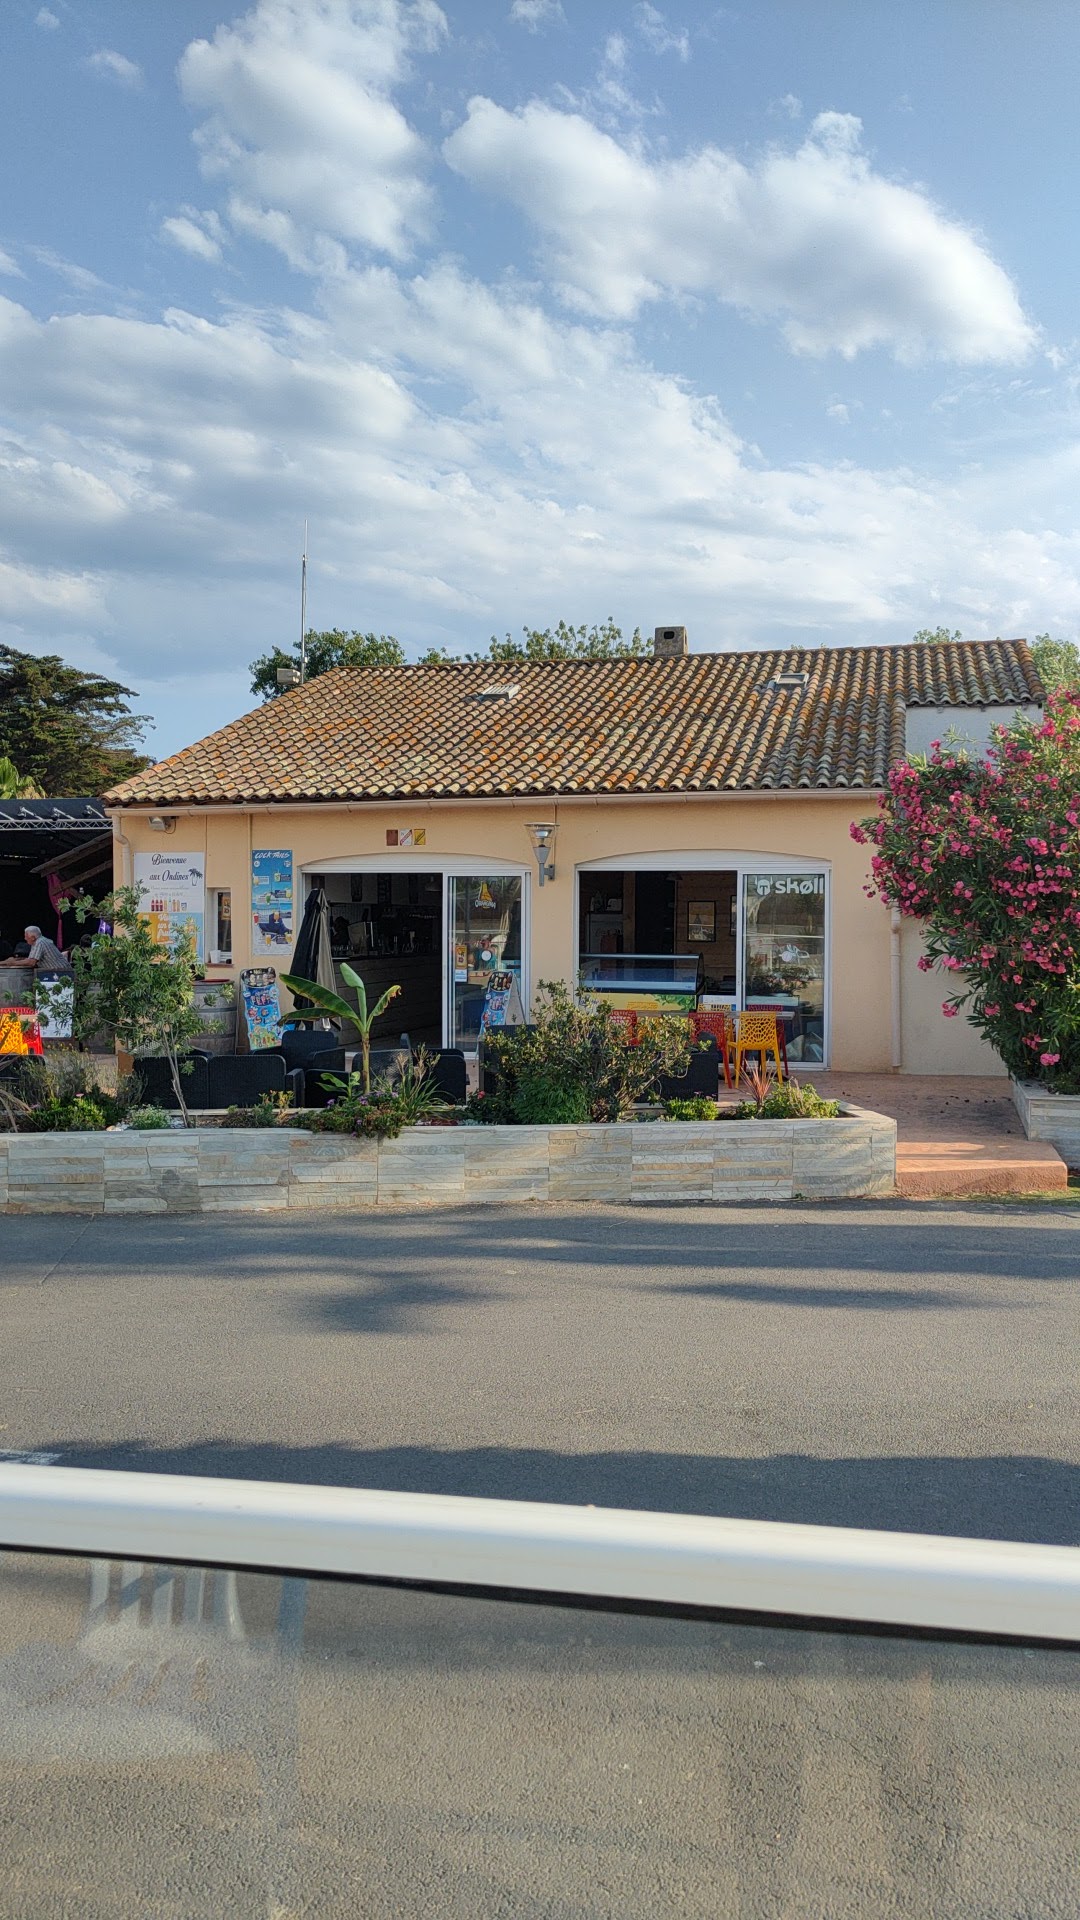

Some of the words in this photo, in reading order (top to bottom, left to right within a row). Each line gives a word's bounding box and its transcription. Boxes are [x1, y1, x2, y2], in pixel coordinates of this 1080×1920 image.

[152, 854, 187, 865] Bienvenue
[162, 870, 189, 881] Ondines
[775, 877, 824, 895] skøll
